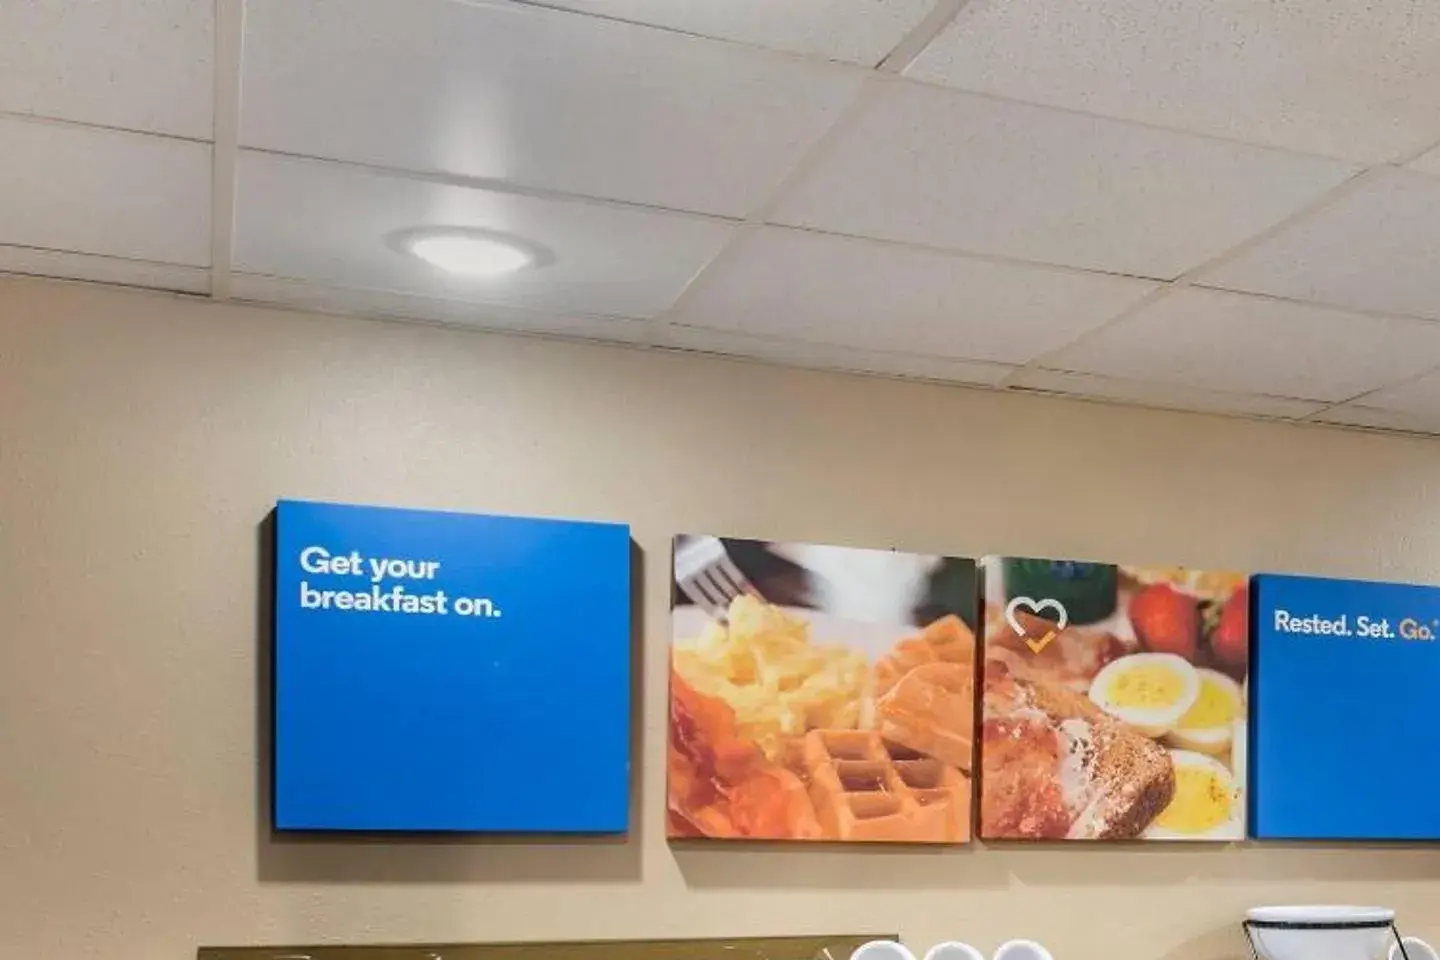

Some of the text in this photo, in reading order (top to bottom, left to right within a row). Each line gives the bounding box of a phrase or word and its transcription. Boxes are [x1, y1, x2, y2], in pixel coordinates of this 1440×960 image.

[300, 546, 440, 583] Get your
[300, 581, 501, 617] breakfast on.
[1274, 609, 1437, 641] Rested. Set. Go.
